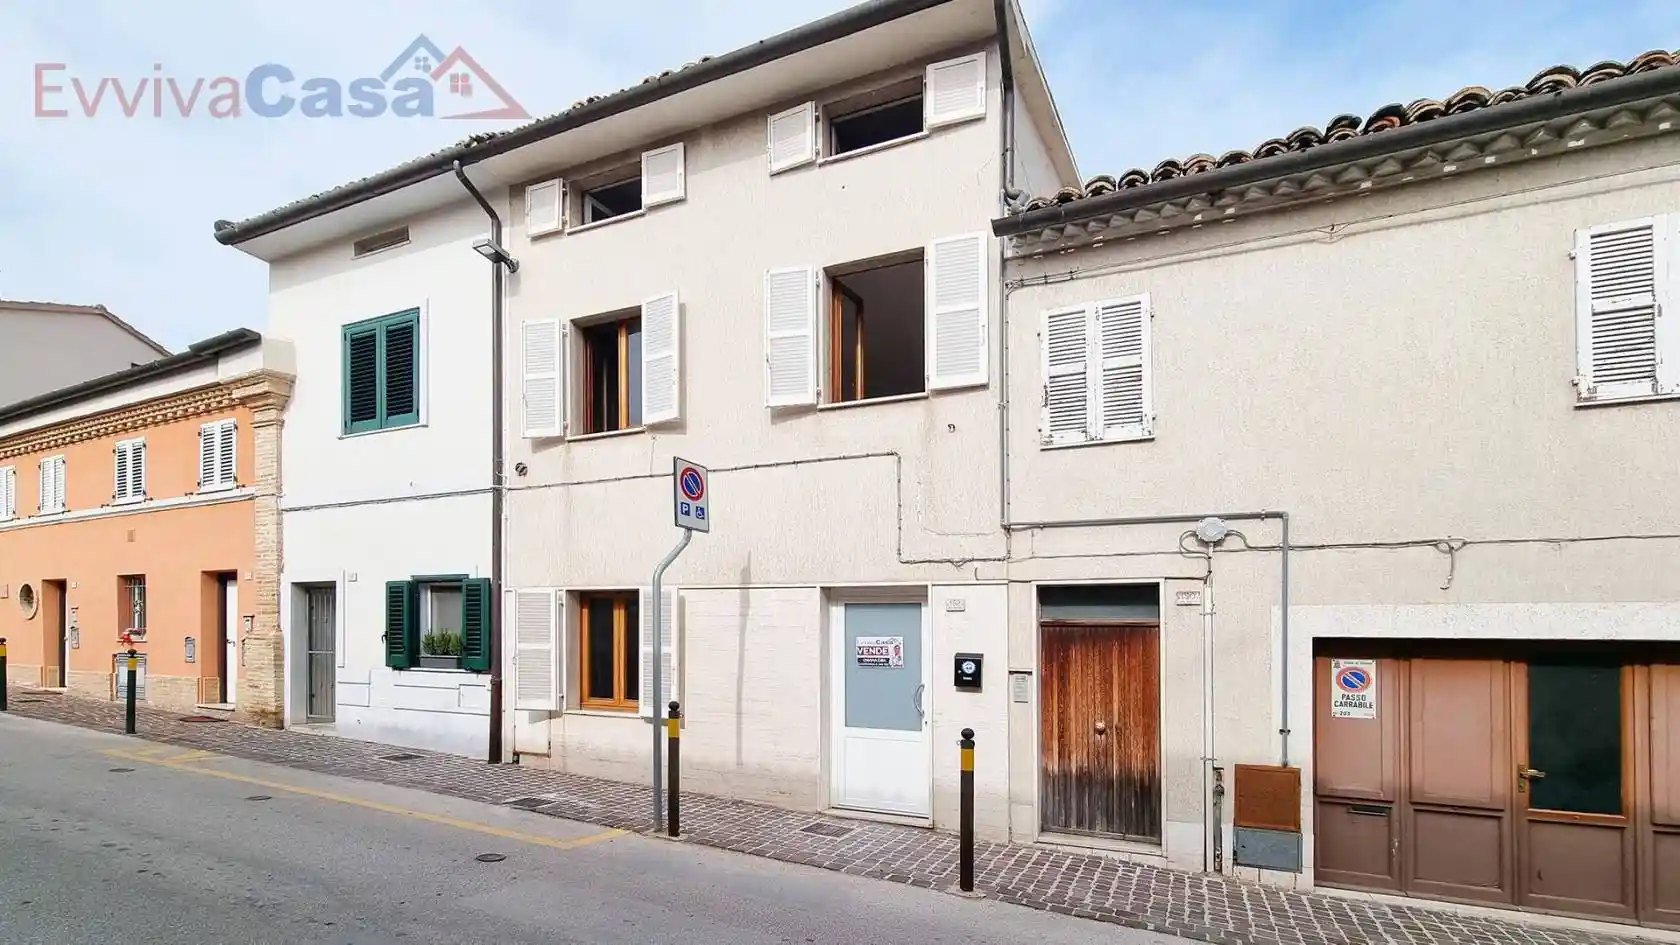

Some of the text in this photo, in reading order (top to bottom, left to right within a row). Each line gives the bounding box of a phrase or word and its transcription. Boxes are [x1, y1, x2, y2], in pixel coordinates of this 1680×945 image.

[857, 646, 889, 655] VENDE
[1341, 694, 1367, 702] PASSO
[1334, 701, 1374, 709] CARRABILE
